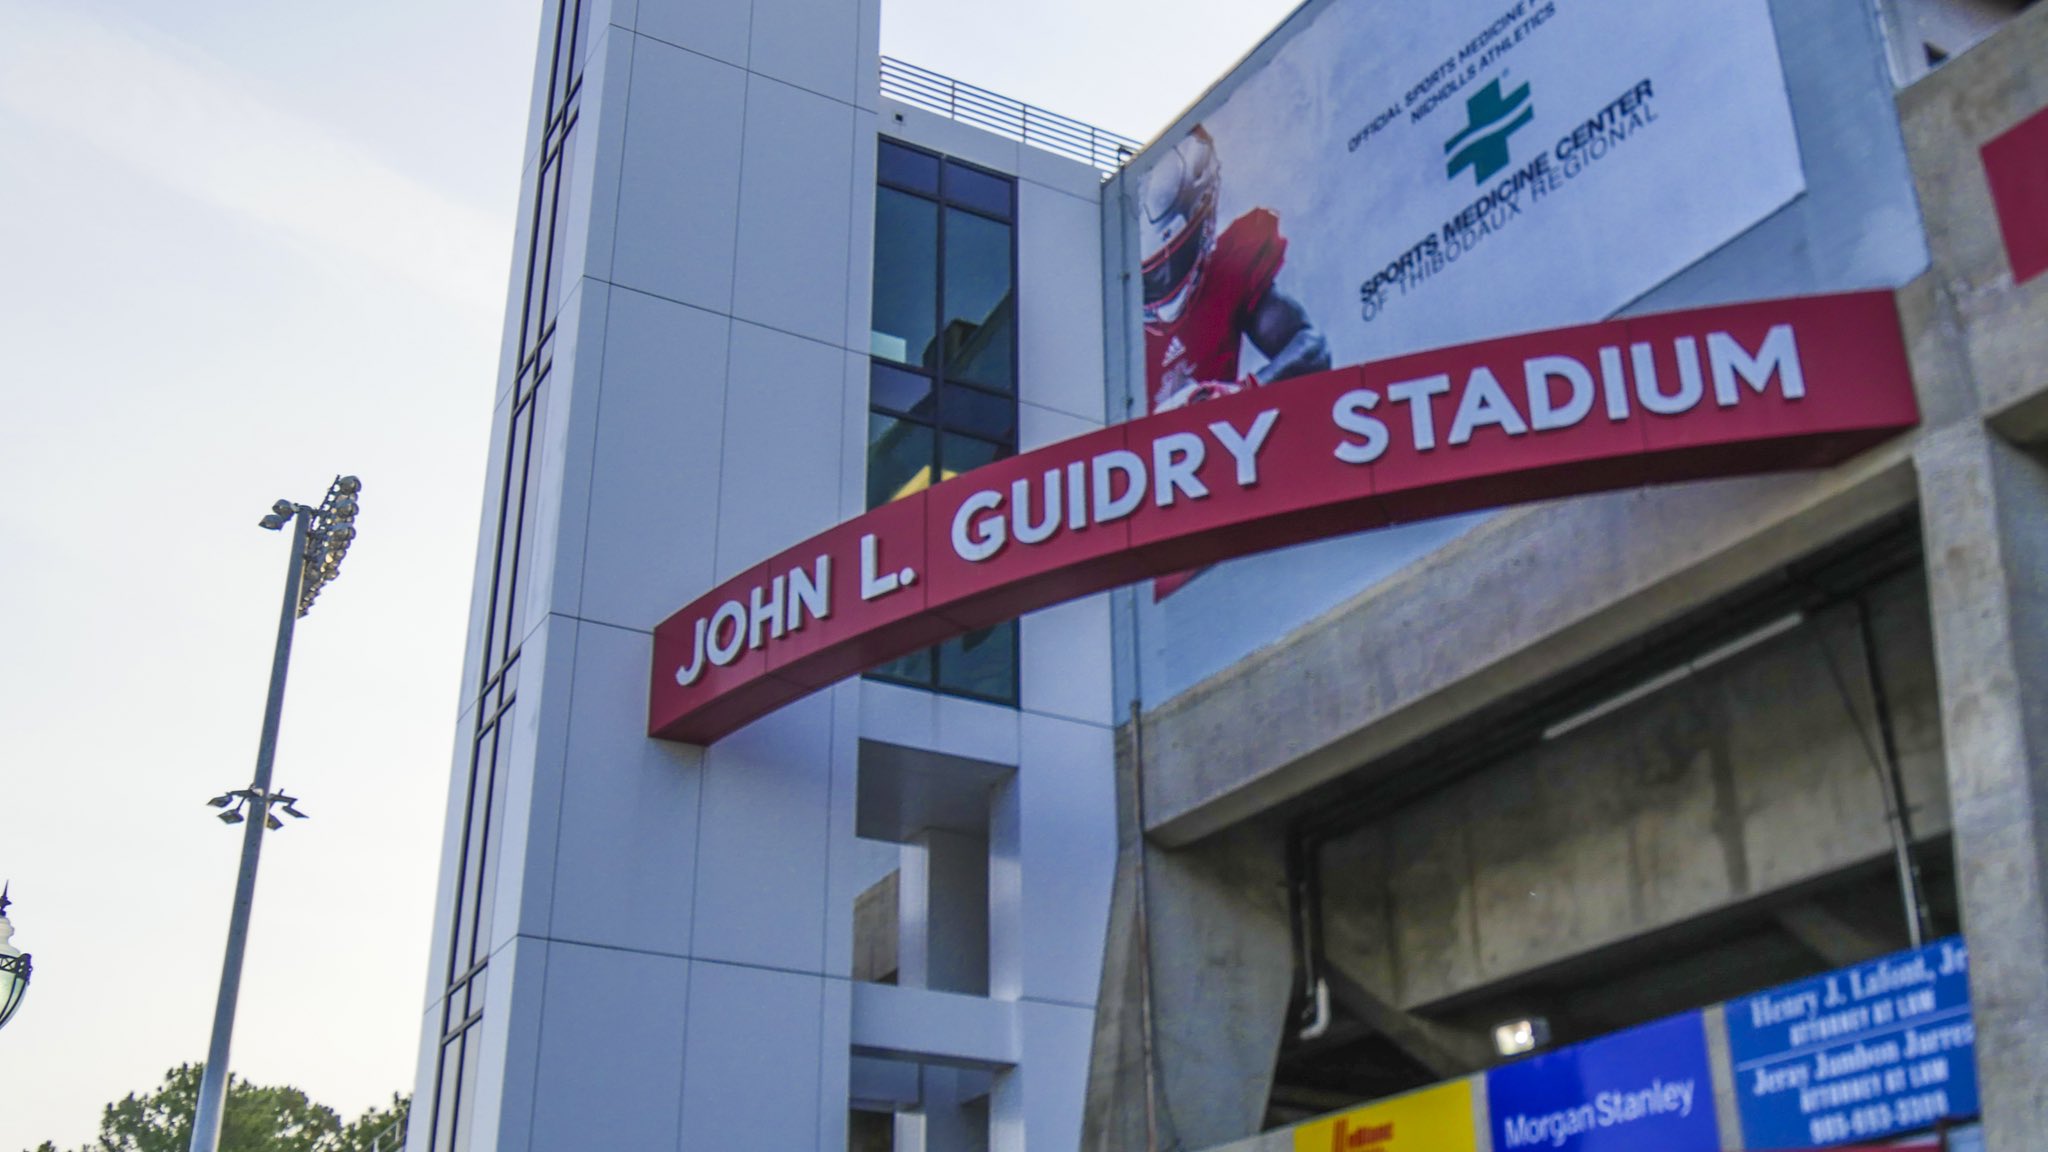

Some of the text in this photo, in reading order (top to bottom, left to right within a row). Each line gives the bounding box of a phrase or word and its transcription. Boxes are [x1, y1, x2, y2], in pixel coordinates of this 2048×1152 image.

[1348, 0, 1526, 152] OFFICIAL SPORTS MEDICINE
[1410, 1, 1556, 124] NICHOLLS ATHLETICS
[1360, 78, 1655, 302] SPORTS MEDICINE CENTER
[1361, 104, 1659, 322] OF THIBODAUX REGIONAL
[675, 324, 1806, 687] JOHN L. GUIDRY STADIUM
